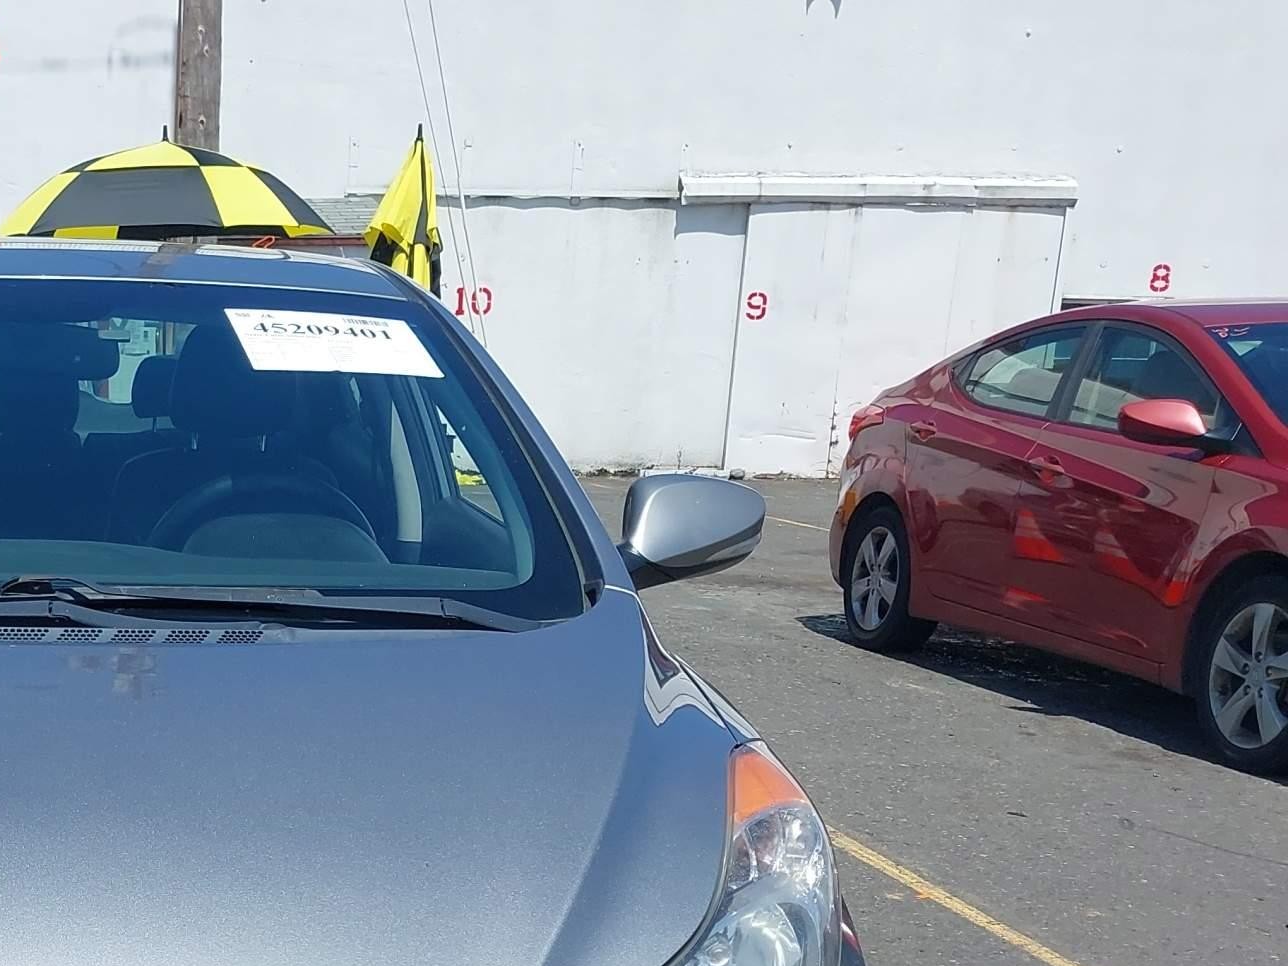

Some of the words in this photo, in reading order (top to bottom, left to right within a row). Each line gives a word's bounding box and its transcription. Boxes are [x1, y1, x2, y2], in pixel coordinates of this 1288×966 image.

[1149, 263, 1171, 292] 8
[455, 287, 492, 316] 10
[745, 291, 768, 321] 9
[252, 321, 393, 341] 45209401
